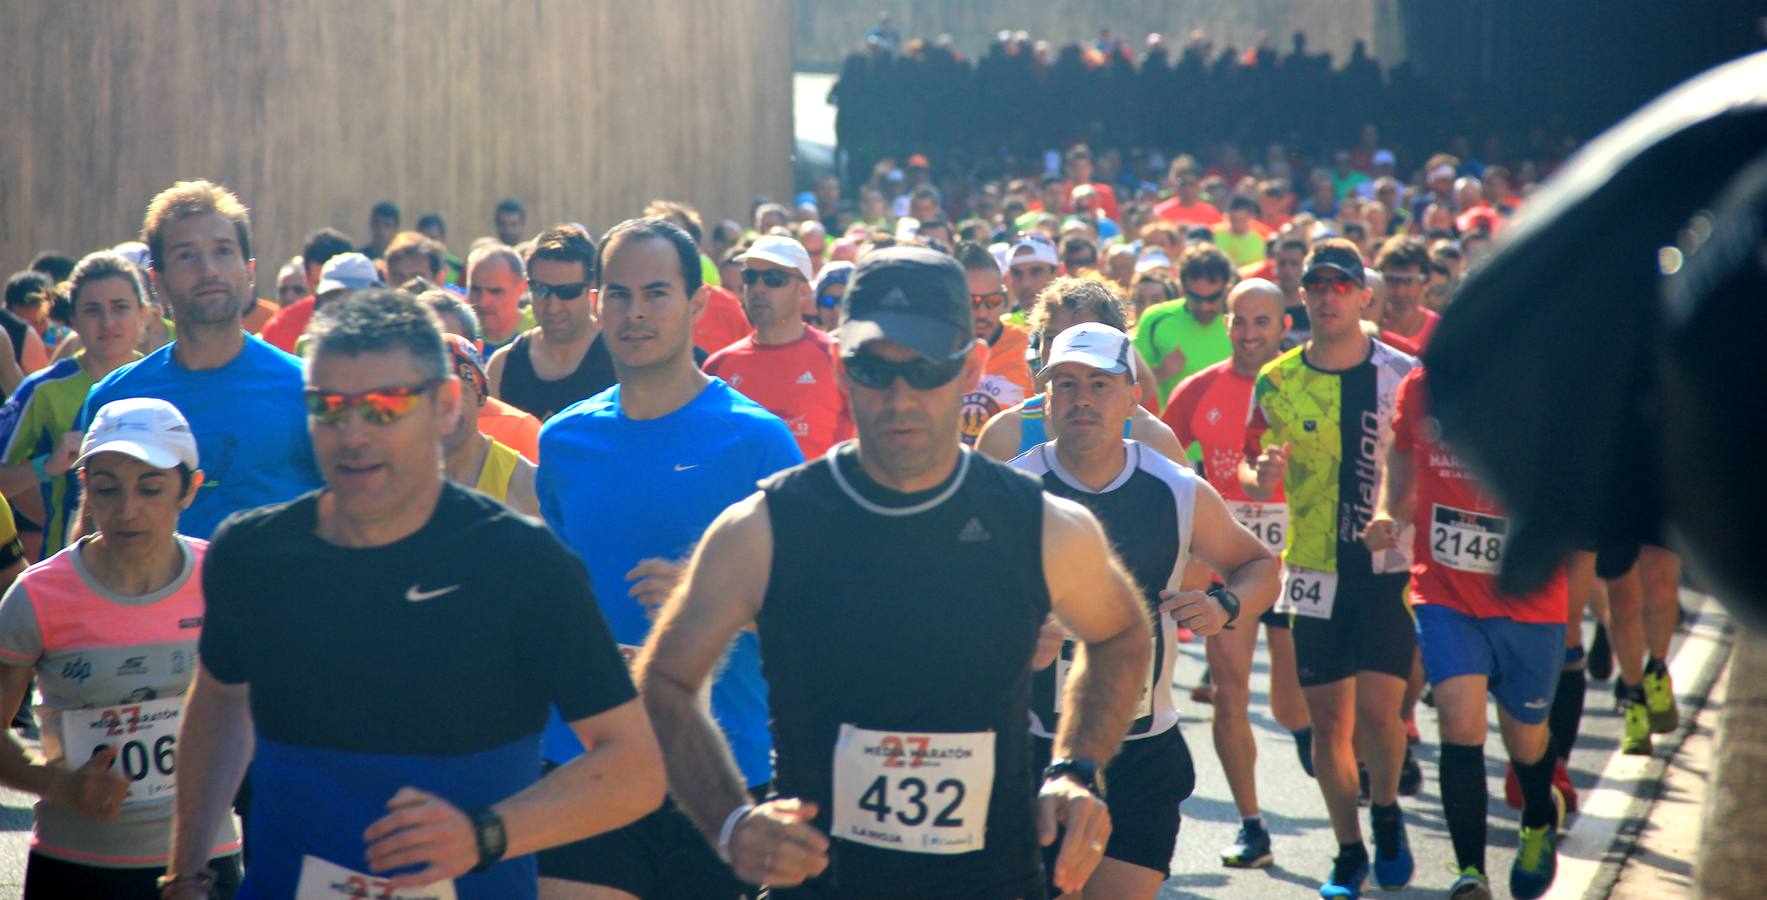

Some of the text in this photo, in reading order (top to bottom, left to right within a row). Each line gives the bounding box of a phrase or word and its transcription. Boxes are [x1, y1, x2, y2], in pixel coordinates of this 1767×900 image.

[1434, 527, 1501, 562] 2148
[101, 706, 141, 737] 27
[880, 735, 931, 769] 27
[858, 774, 967, 828] 432
